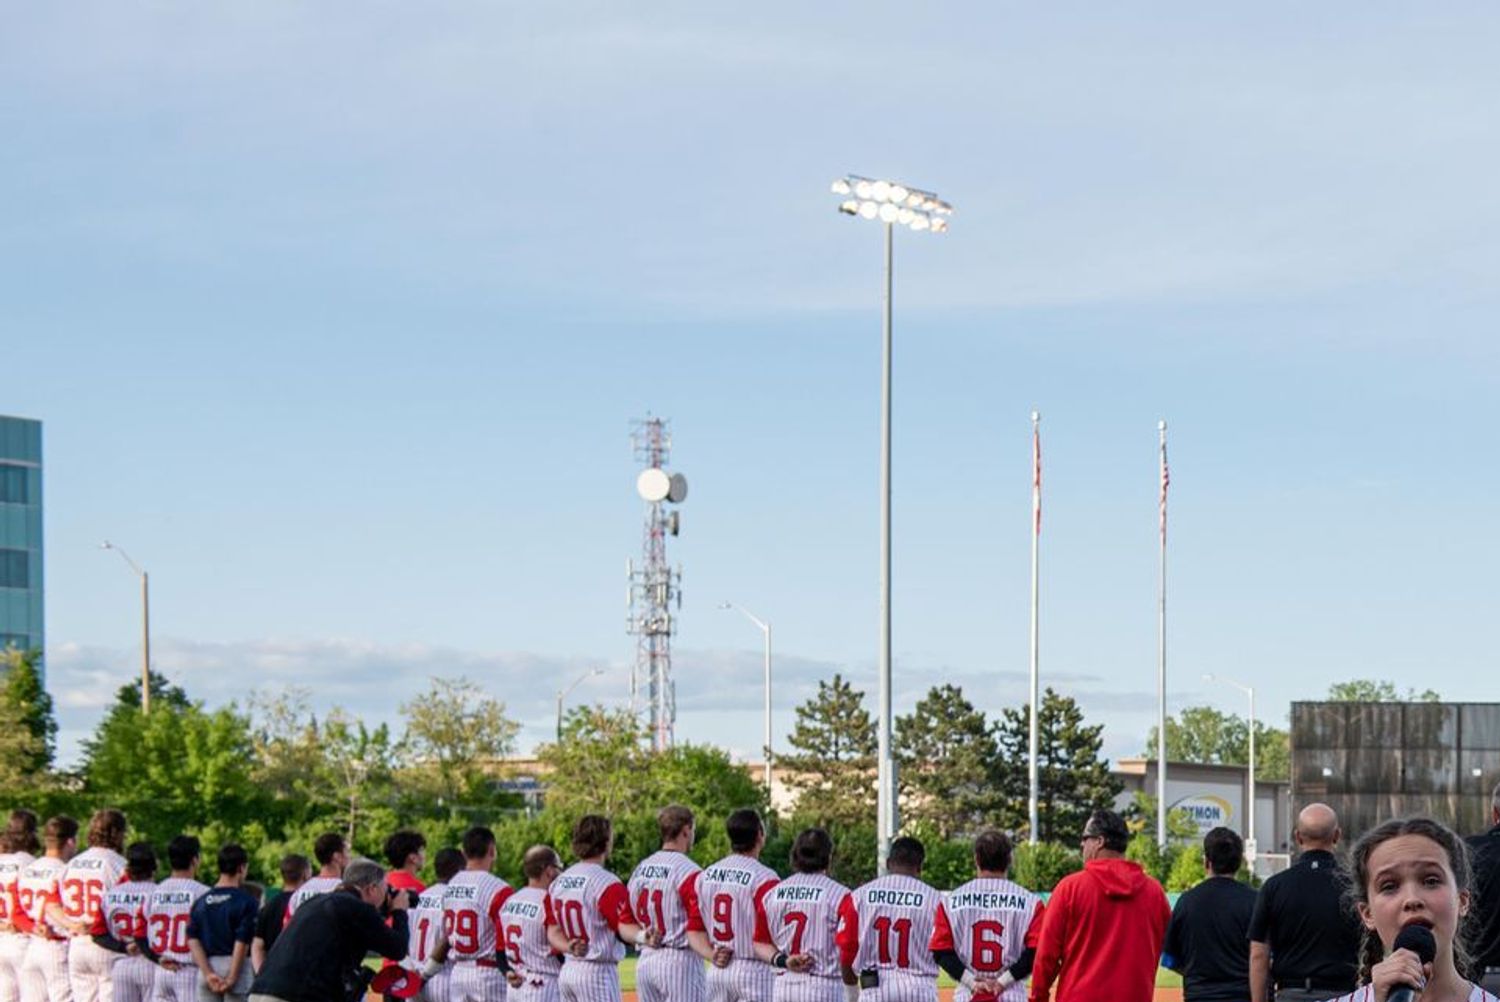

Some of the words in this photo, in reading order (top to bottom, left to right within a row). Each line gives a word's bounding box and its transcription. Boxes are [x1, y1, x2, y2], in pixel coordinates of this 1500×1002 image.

[445, 885, 477, 900] GREENE
[705, 868, 752, 885] SANFORD
[776, 887, 823, 902] WRIGHT
[62, 878, 103, 918] 36
[636, 888, 666, 938] 41
[713, 893, 734, 942] 9
[868, 890, 923, 907] OROZCO
[951, 893, 1026, 910] ZIMMERMAN
[150, 913, 192, 954] 30
[784, 911, 808, 956] 7
[873, 916, 912, 968] 11
[971, 919, 1005, 973] 6
